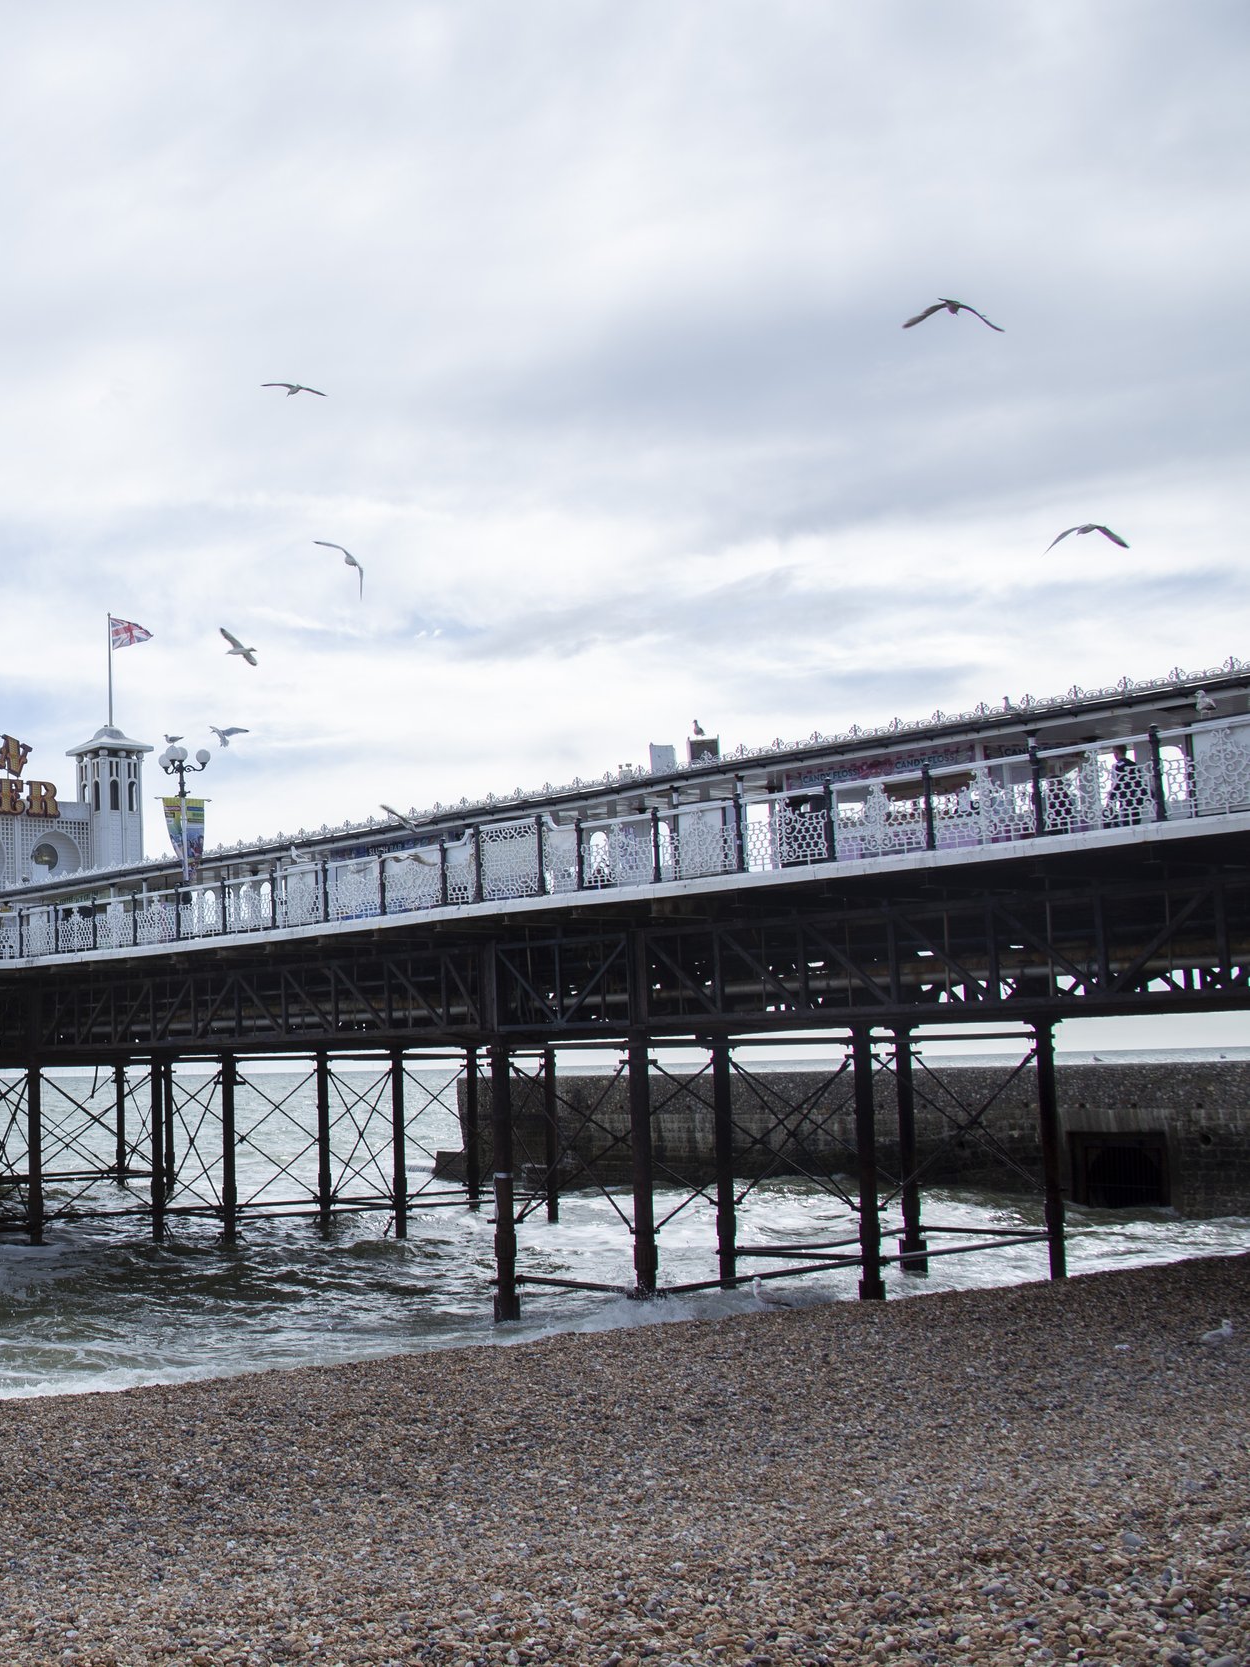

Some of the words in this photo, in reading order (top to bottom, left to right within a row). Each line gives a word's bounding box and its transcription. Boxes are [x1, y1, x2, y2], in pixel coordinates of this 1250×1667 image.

[895, 757, 926, 770] CANDY
[927, 752, 955, 764] FLOSS
[803, 772, 831, 784] CANDY
[833, 768, 859, 780] FLOSS
